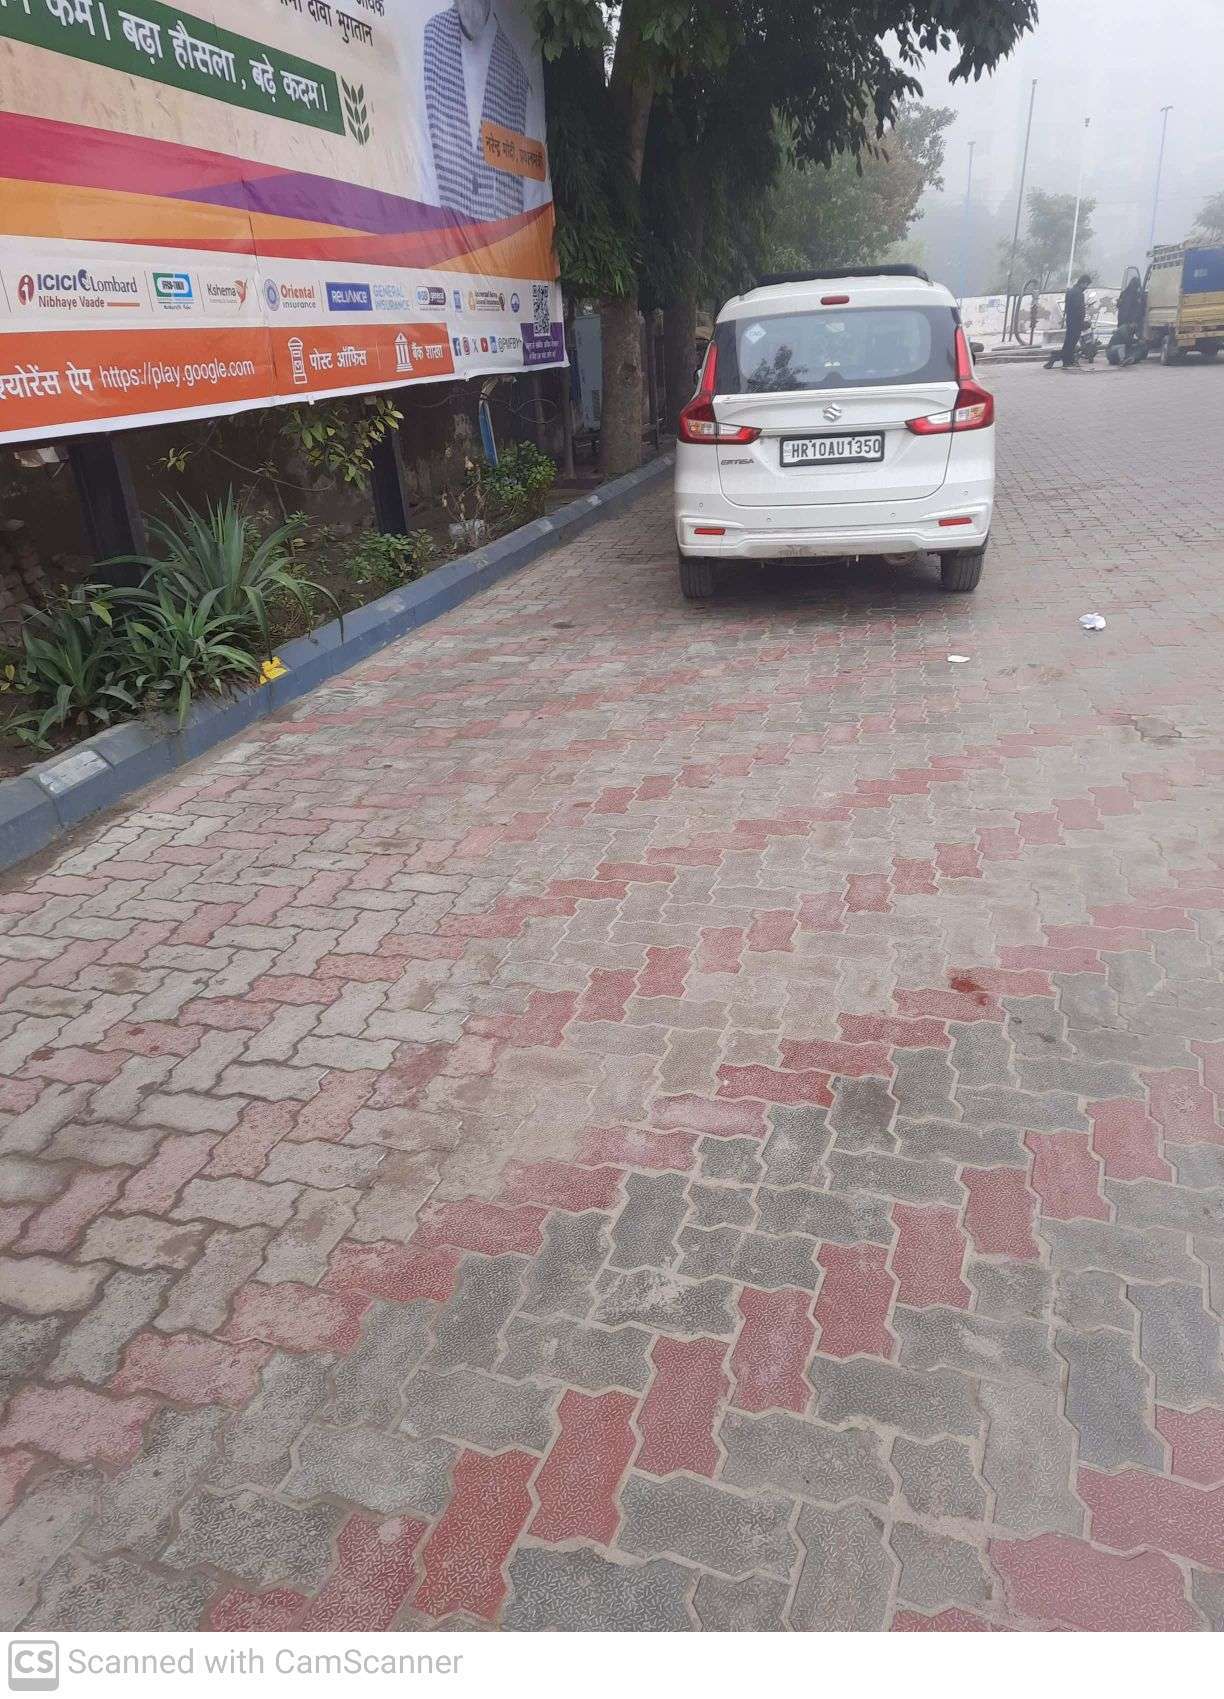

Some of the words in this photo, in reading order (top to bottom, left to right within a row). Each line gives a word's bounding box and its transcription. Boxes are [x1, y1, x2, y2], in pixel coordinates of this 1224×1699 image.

[307, 0, 332, 27] दावा
[336, 9, 374, 46] भुगतान
[118, 10, 163, 64] बढ़ा
[249, 54, 276, 103] बढ़े
[280, 70, 328, 112] कदम।
[37, 274, 78, 291] ICICI
[90, 274, 138, 293] Lombard
[207, 284, 236, 297] Kshema
[280, 284, 315, 299] Oriental
[38, 295, 78, 310] Nibhaye
[79, 295, 105, 308] Vaade
[309, 348, 333, 371] पोस्ट
[425, 344, 444, 359] शाखा
[65, 361, 95, 395] ऐप
[99, 358, 255, 393] https://play.google.com
[791, 438, 881, 458] HR10AU1350
